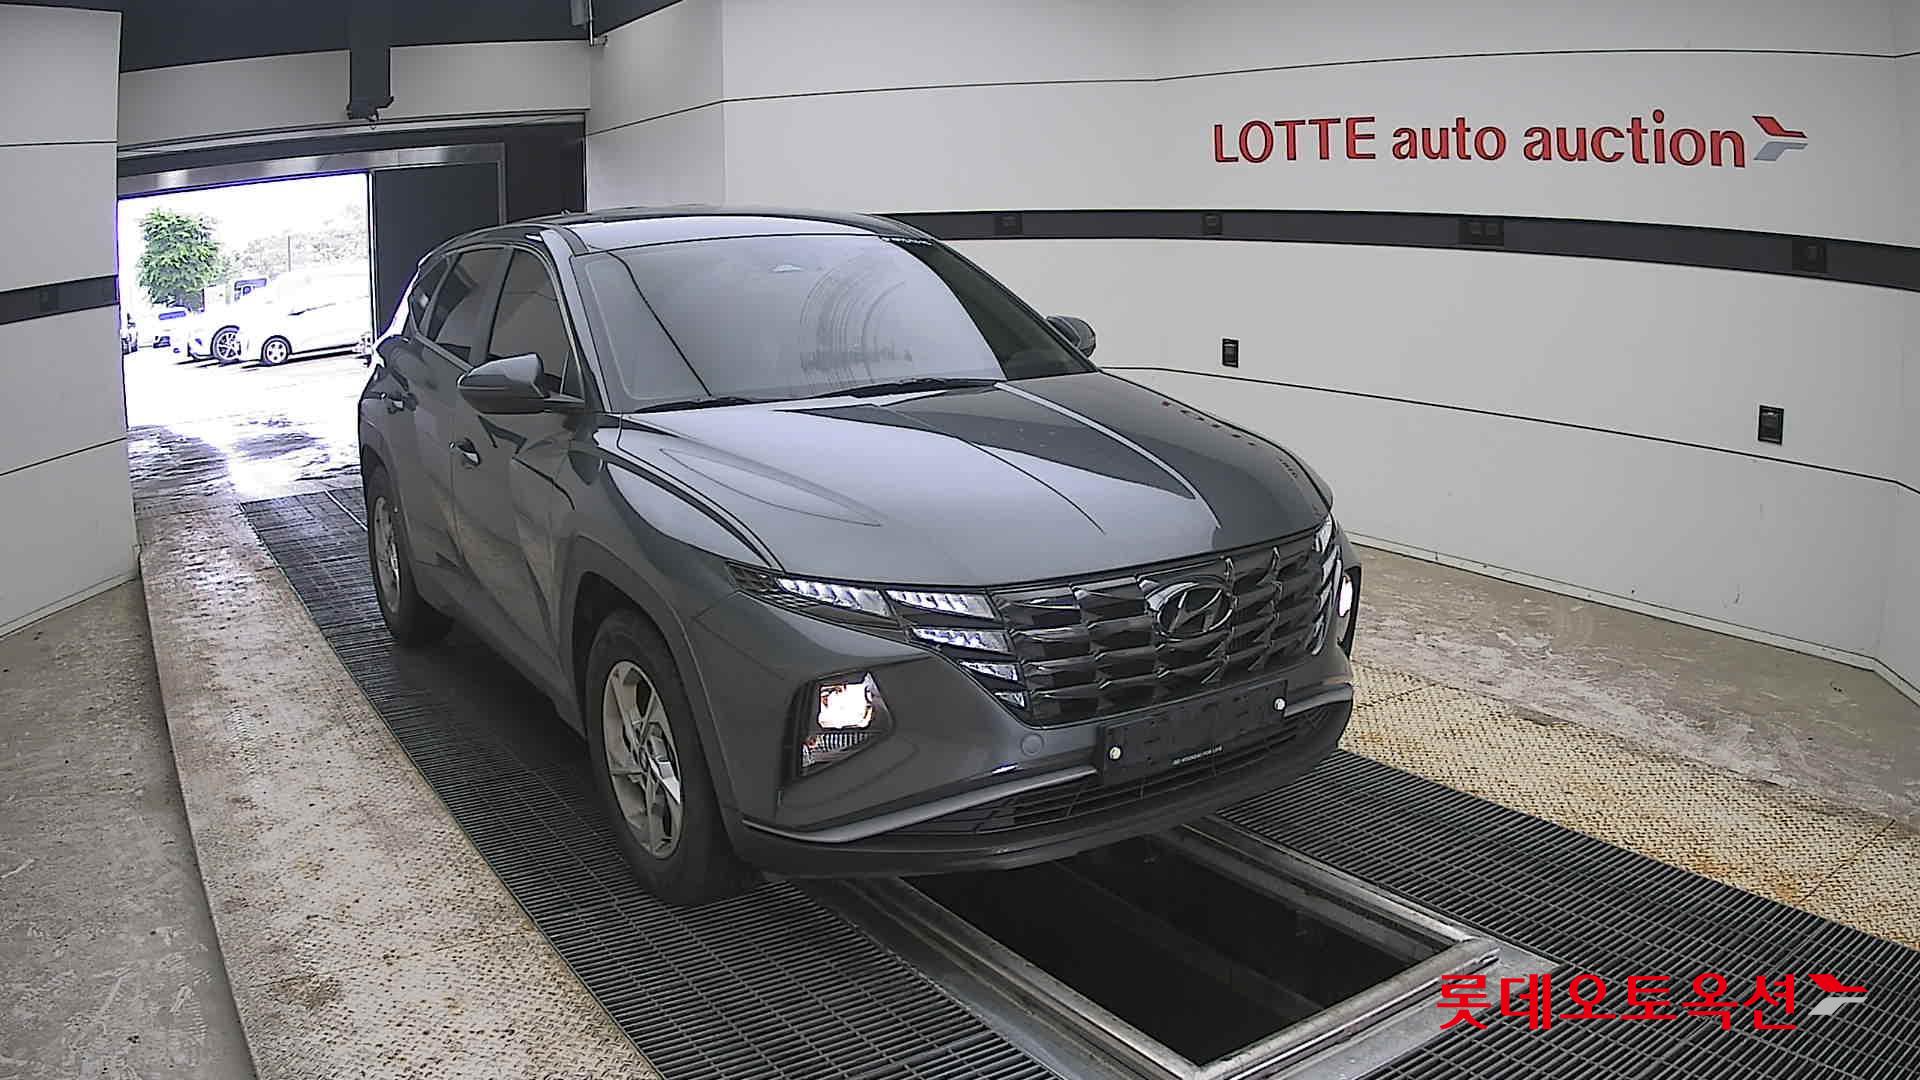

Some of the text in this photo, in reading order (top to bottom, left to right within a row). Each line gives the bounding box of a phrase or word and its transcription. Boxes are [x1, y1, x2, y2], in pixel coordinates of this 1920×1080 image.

[1213, 109, 1746, 168] LOTTE auto auction
